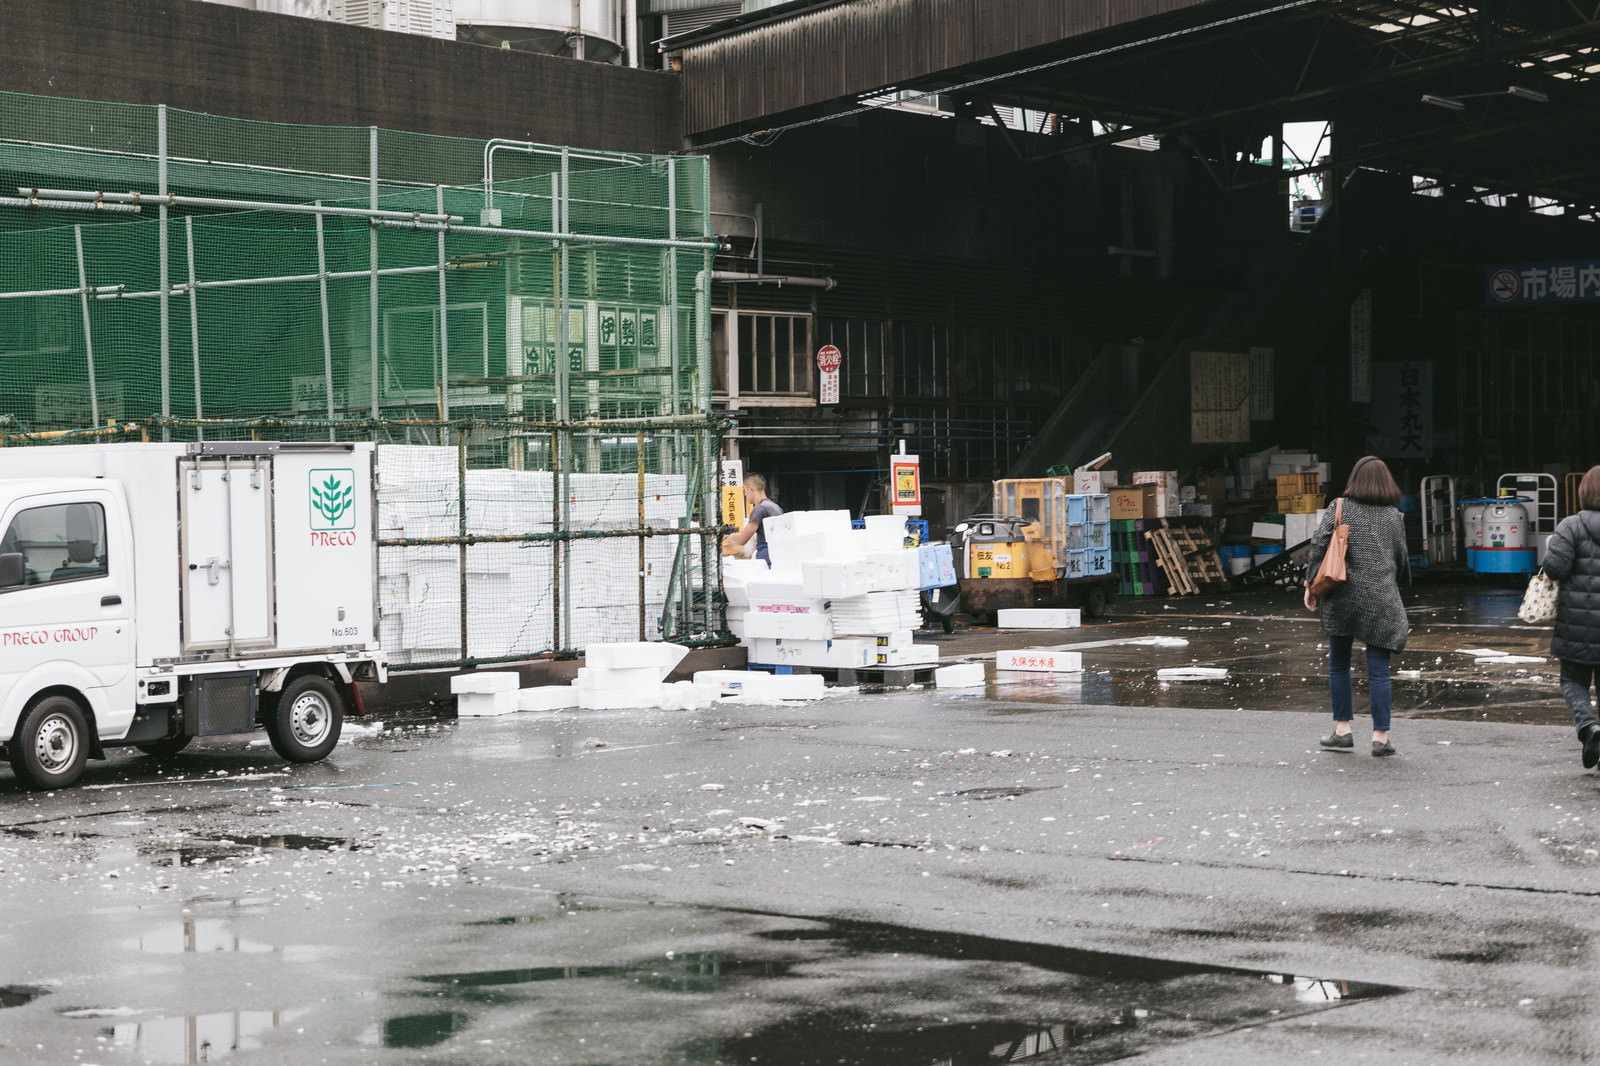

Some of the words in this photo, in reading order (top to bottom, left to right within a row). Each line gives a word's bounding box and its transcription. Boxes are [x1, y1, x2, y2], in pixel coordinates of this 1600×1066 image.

[1521, 264, 1600, 300] 市場内
[310, 531, 356, 547] PRECO
[3, 630, 48, 646] PRECO
[54, 626, 98, 643] GROUP
